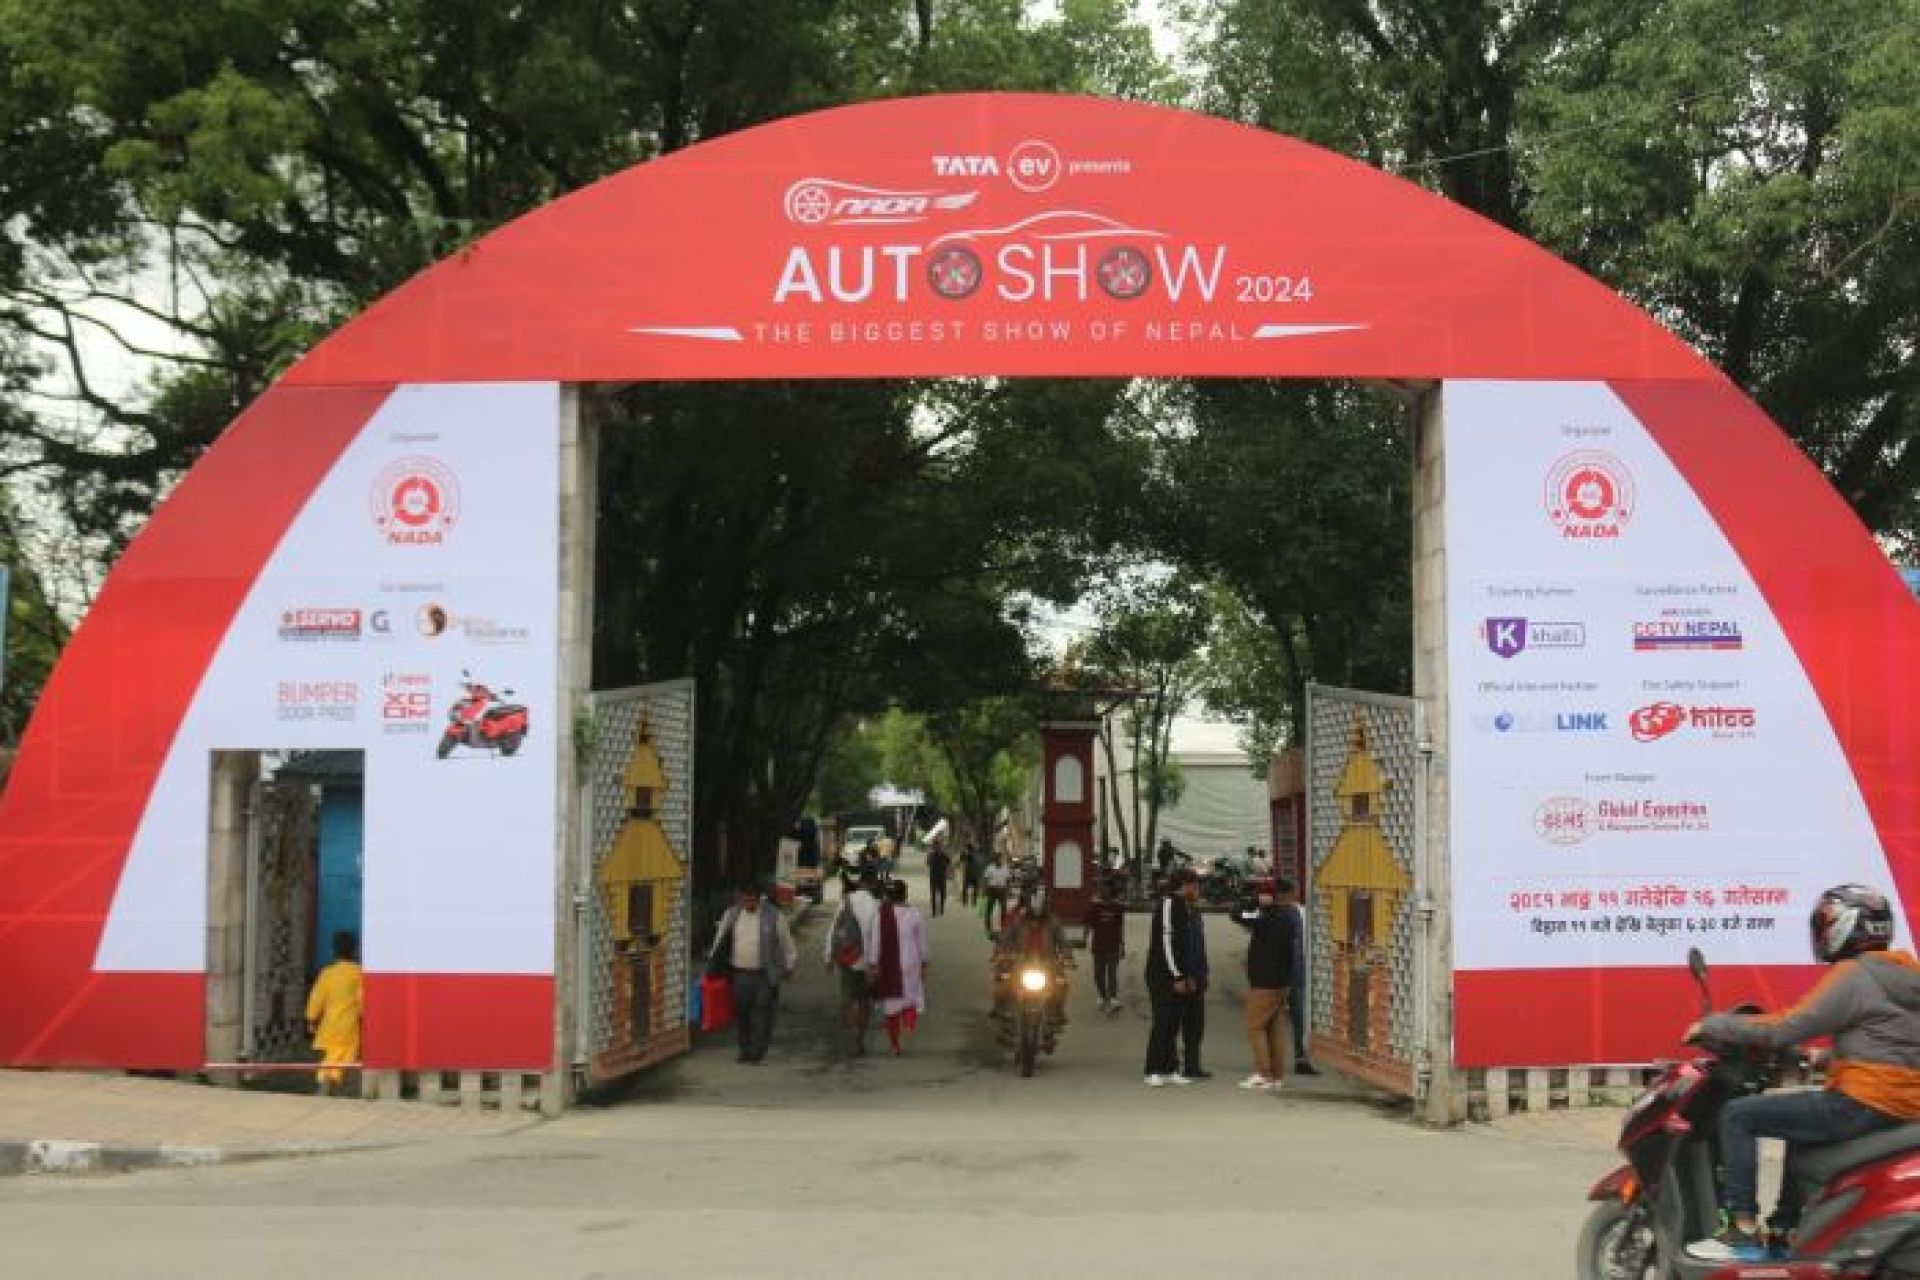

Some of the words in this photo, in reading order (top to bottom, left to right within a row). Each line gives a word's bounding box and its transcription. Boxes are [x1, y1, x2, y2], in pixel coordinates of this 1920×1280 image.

[932, 156, 999, 176] TATA
[1018, 157, 1051, 176] ev
[1236, 276, 1313, 302] 2024
[754, 323, 811, 342] THE
[830, 322, 963, 341] BIGGEST
[984, 321, 1070, 340] SHOW
[1091, 321, 1124, 340] OF
[1146, 321, 1245, 341] NEPAL
[1562, 525, 1619, 538] NADA
[1496, 623, 1517, 649] K
[1634, 622, 1680, 636] CCTV
[1685, 621, 1740, 636] NEPAL
[278, 682, 358, 702] BUMPER
[1598, 799, 1639, 818] Global
